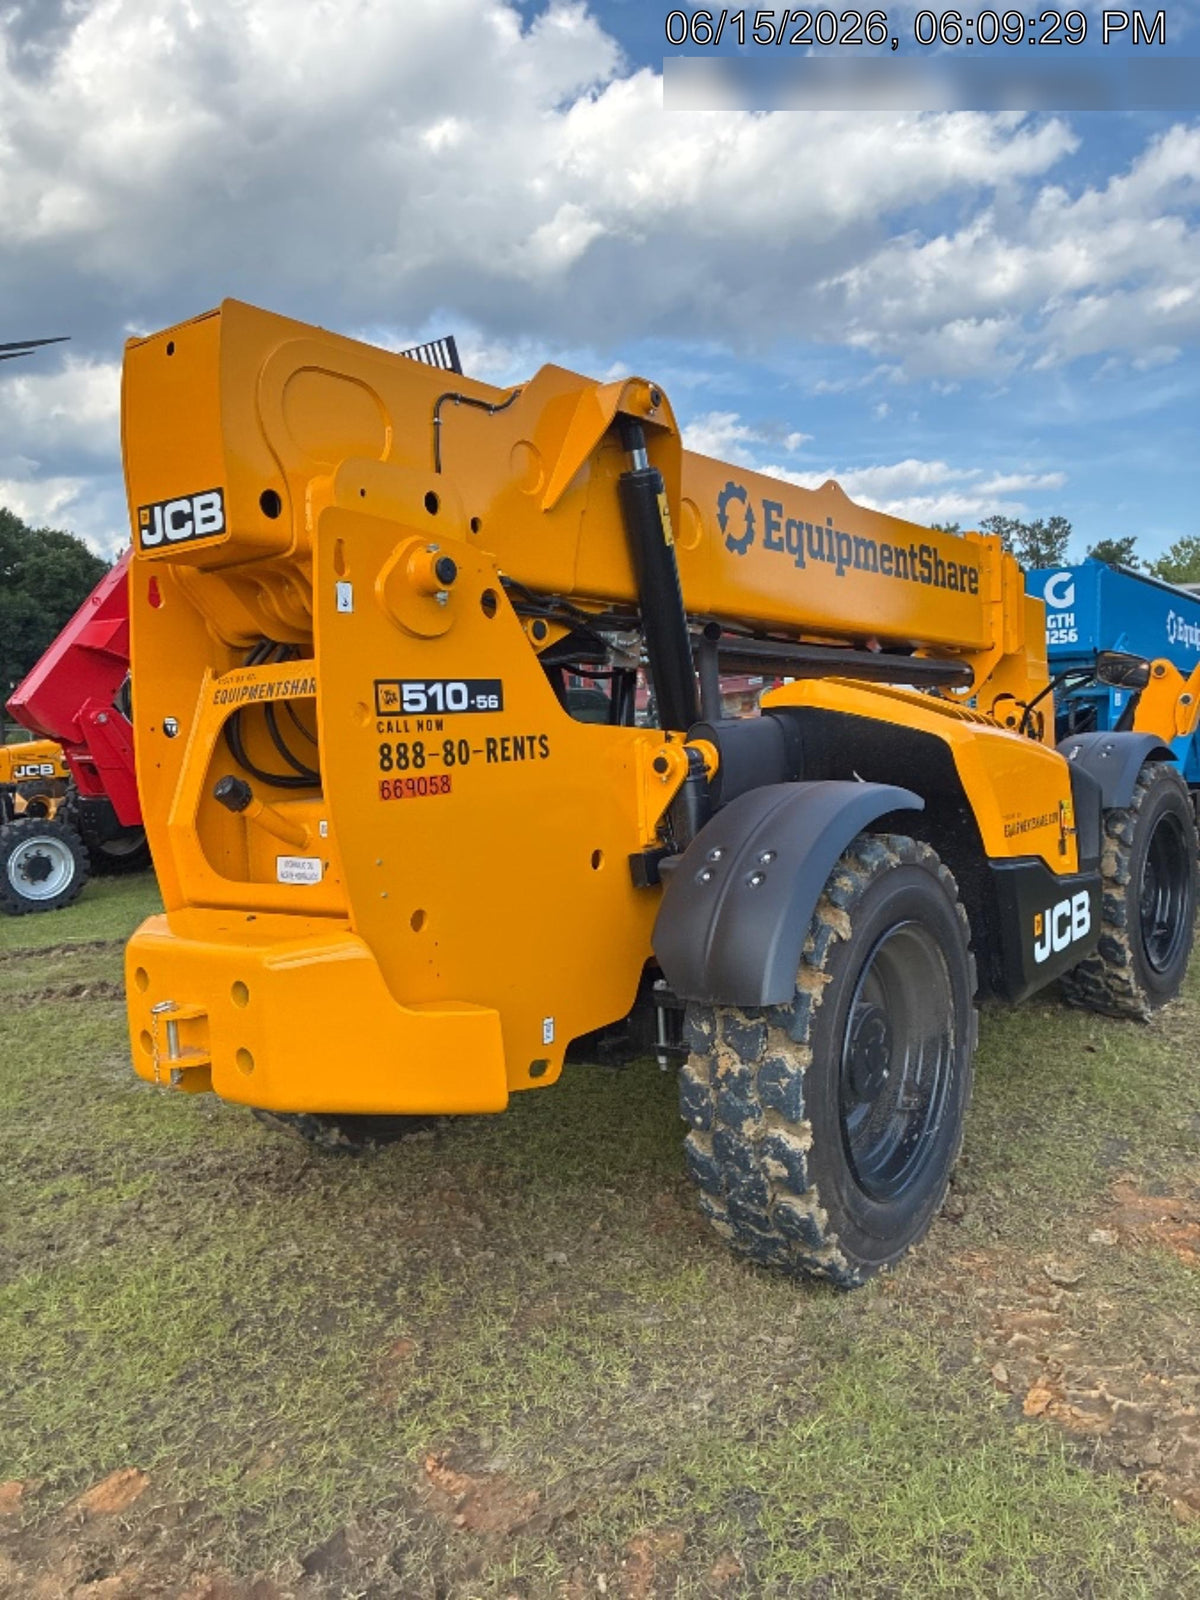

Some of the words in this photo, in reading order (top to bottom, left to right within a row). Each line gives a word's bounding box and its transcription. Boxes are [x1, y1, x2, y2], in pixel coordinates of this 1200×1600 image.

[141, 491, 224, 546] JCB
[762, 499, 979, 596] EquipmentShare
[1047, 613, 1075, 628] GTH
[376, 720, 410, 734] CALL
[416, 718, 444, 732] NOW
[379, 734, 550, 772] 888-80-RENTS
[14, 763, 54, 778] JCB
[380, 775, 451, 800] 669058
[1034, 890, 1091, 963] JCB
